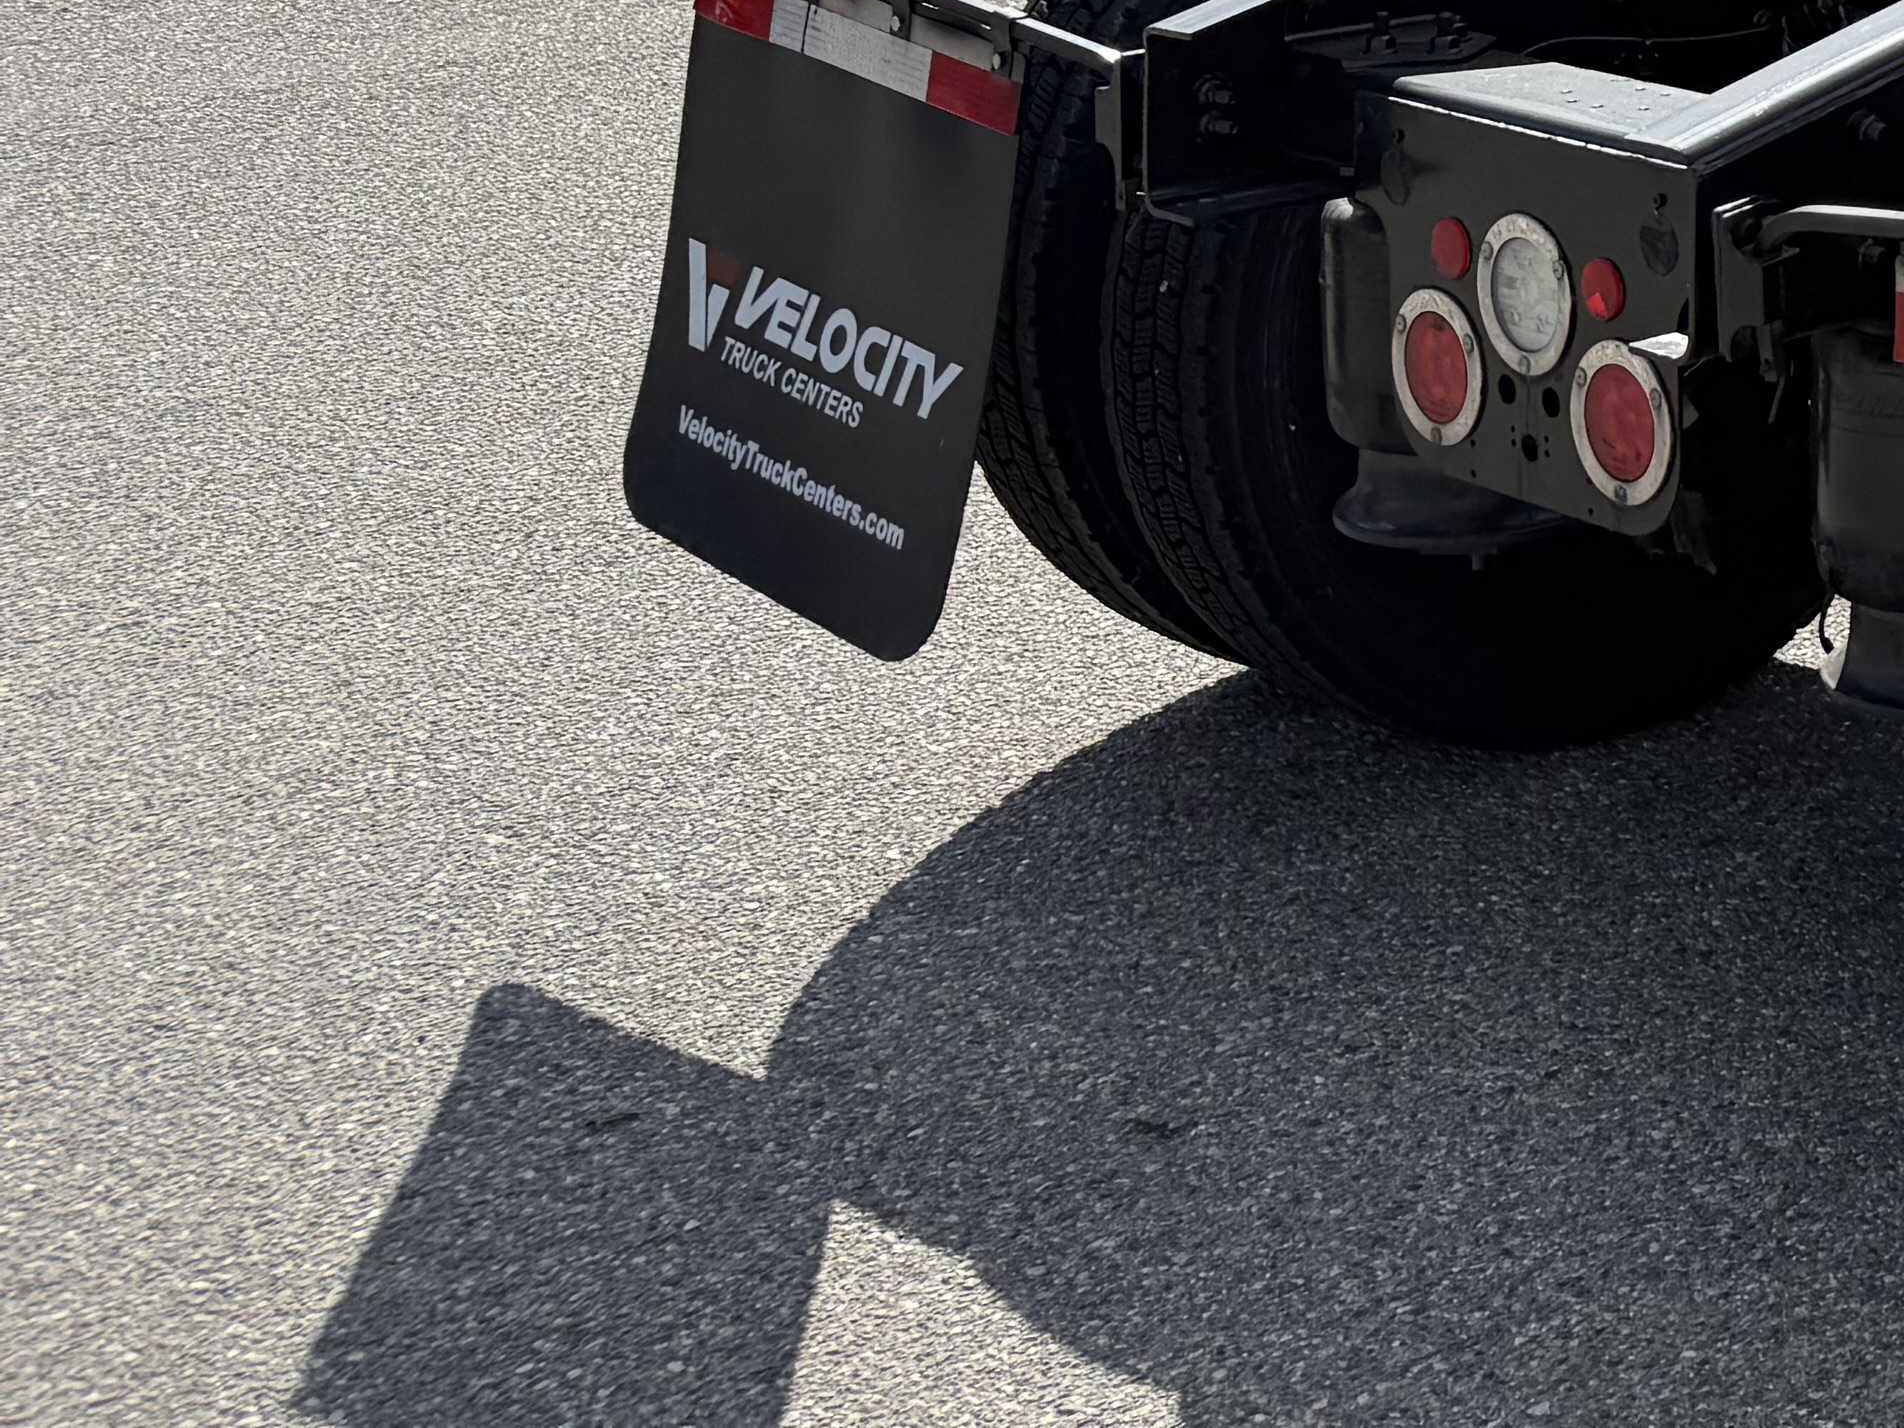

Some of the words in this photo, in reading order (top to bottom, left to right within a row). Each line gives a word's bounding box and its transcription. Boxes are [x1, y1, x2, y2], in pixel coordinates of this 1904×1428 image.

[720, 336, 782, 388] TRUCK
[781, 367, 864, 429] CENTERS
[734, 265, 964, 420] VELOCITY
[678, 404, 905, 550] VelocityTruckCenters.com
